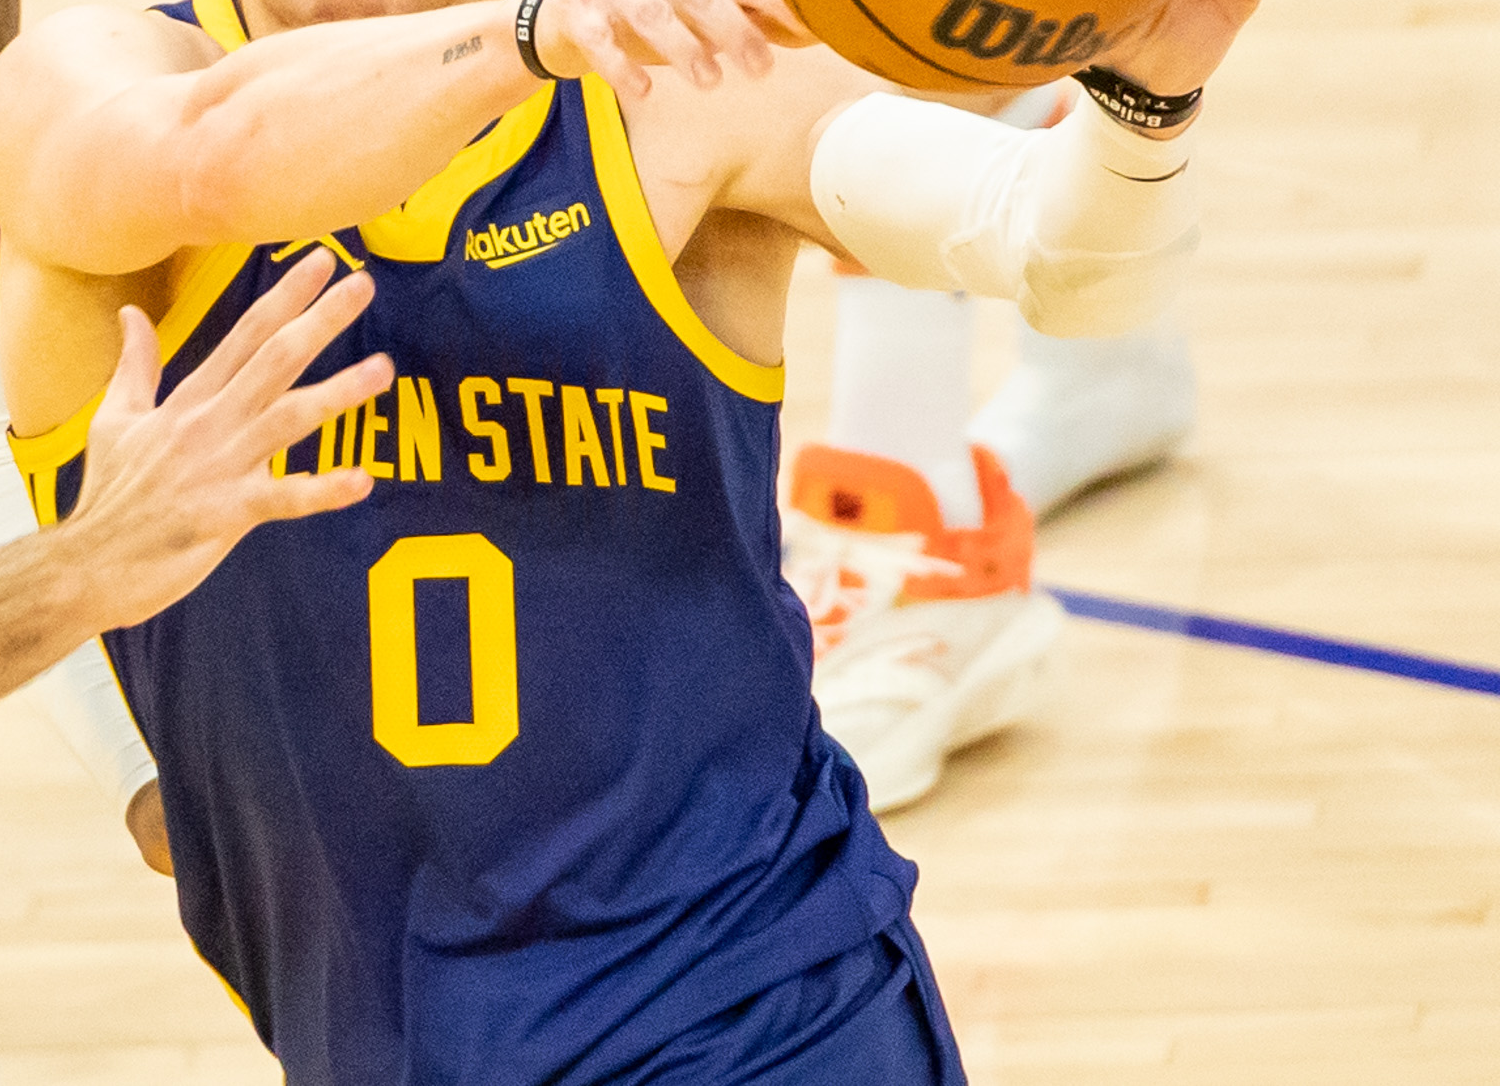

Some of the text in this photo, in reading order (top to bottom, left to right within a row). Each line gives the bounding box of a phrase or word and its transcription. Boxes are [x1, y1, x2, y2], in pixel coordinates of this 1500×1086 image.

[464, 202, 592, 262] Rakuten
[458, 376, 677, 494] STATE
[368, 532, 520, 768] 0
